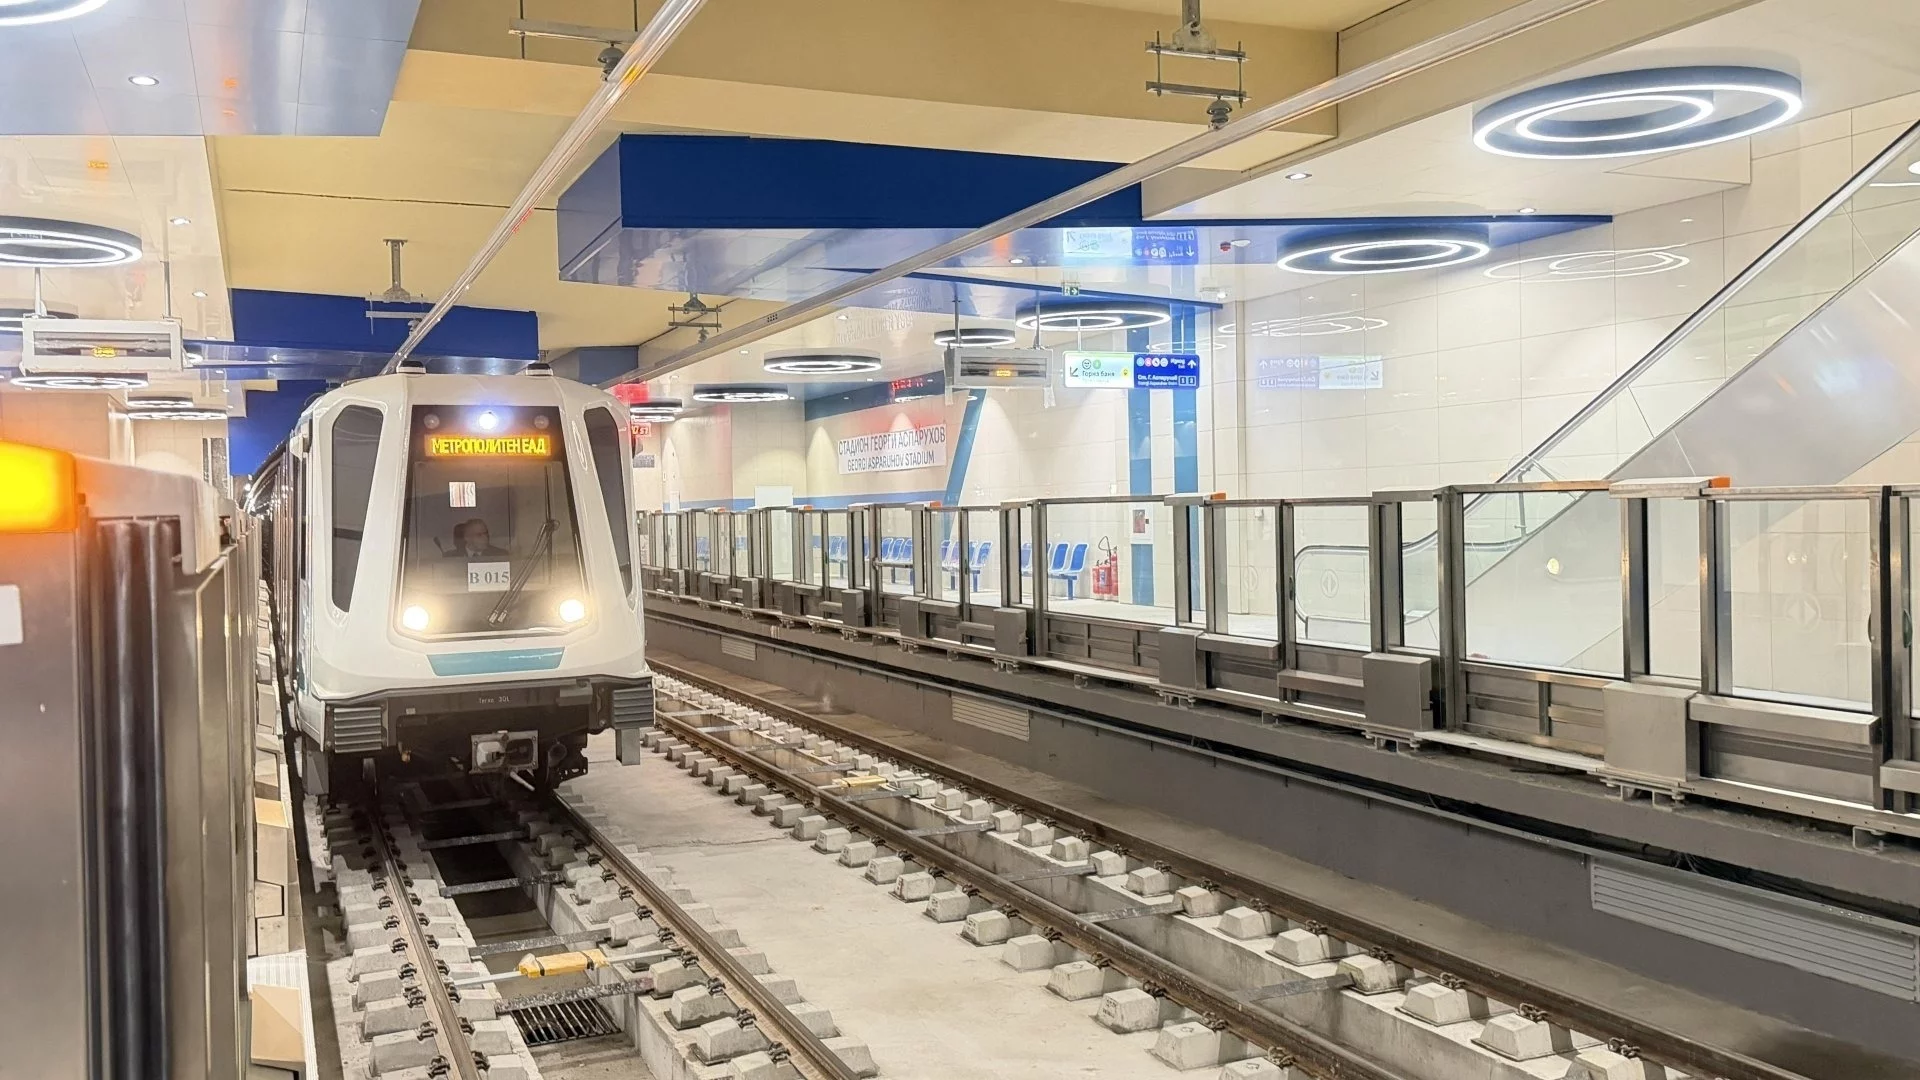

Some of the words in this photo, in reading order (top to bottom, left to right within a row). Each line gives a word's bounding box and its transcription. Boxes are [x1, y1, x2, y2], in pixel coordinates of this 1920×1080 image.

[431, 438, 521, 454] МЕТРОПОЛИТЕН
[839, 436, 869, 456] СТАДИОН
[870, 433, 897, 452] ГЕОРГИ
[899, 426, 946, 447] АСПАРУХОВ
[847, 458, 867, 472] GEORGI
[868, 453, 905, 470] ASPARUHOV
[905, 450, 935, 466] STADIUM
[484, 571, 509, 584] 015
